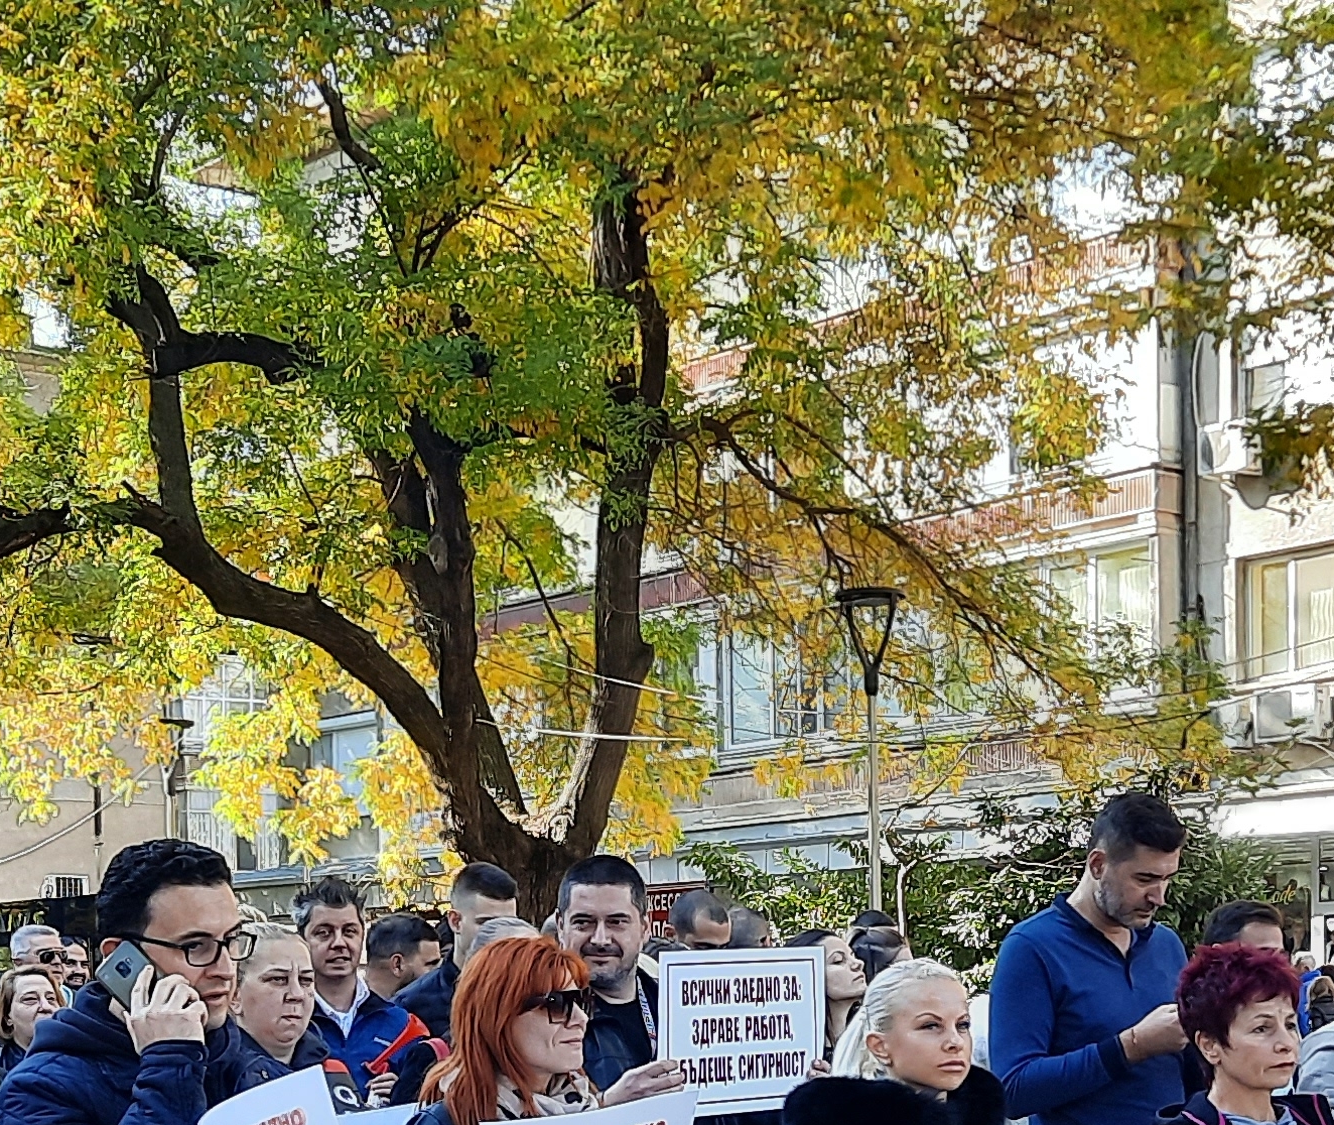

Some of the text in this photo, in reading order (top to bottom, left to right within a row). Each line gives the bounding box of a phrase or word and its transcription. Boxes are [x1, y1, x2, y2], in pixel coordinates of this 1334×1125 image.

[681, 974, 802, 1008] ВСИЧКИ ЗАЕДНО ЗА:
[692, 1013, 794, 1050] ЗДРАВЕ, РАБОТА,
[679, 1050, 806, 1089] БЪДЕЩЕ, СИГУРНОСТ
